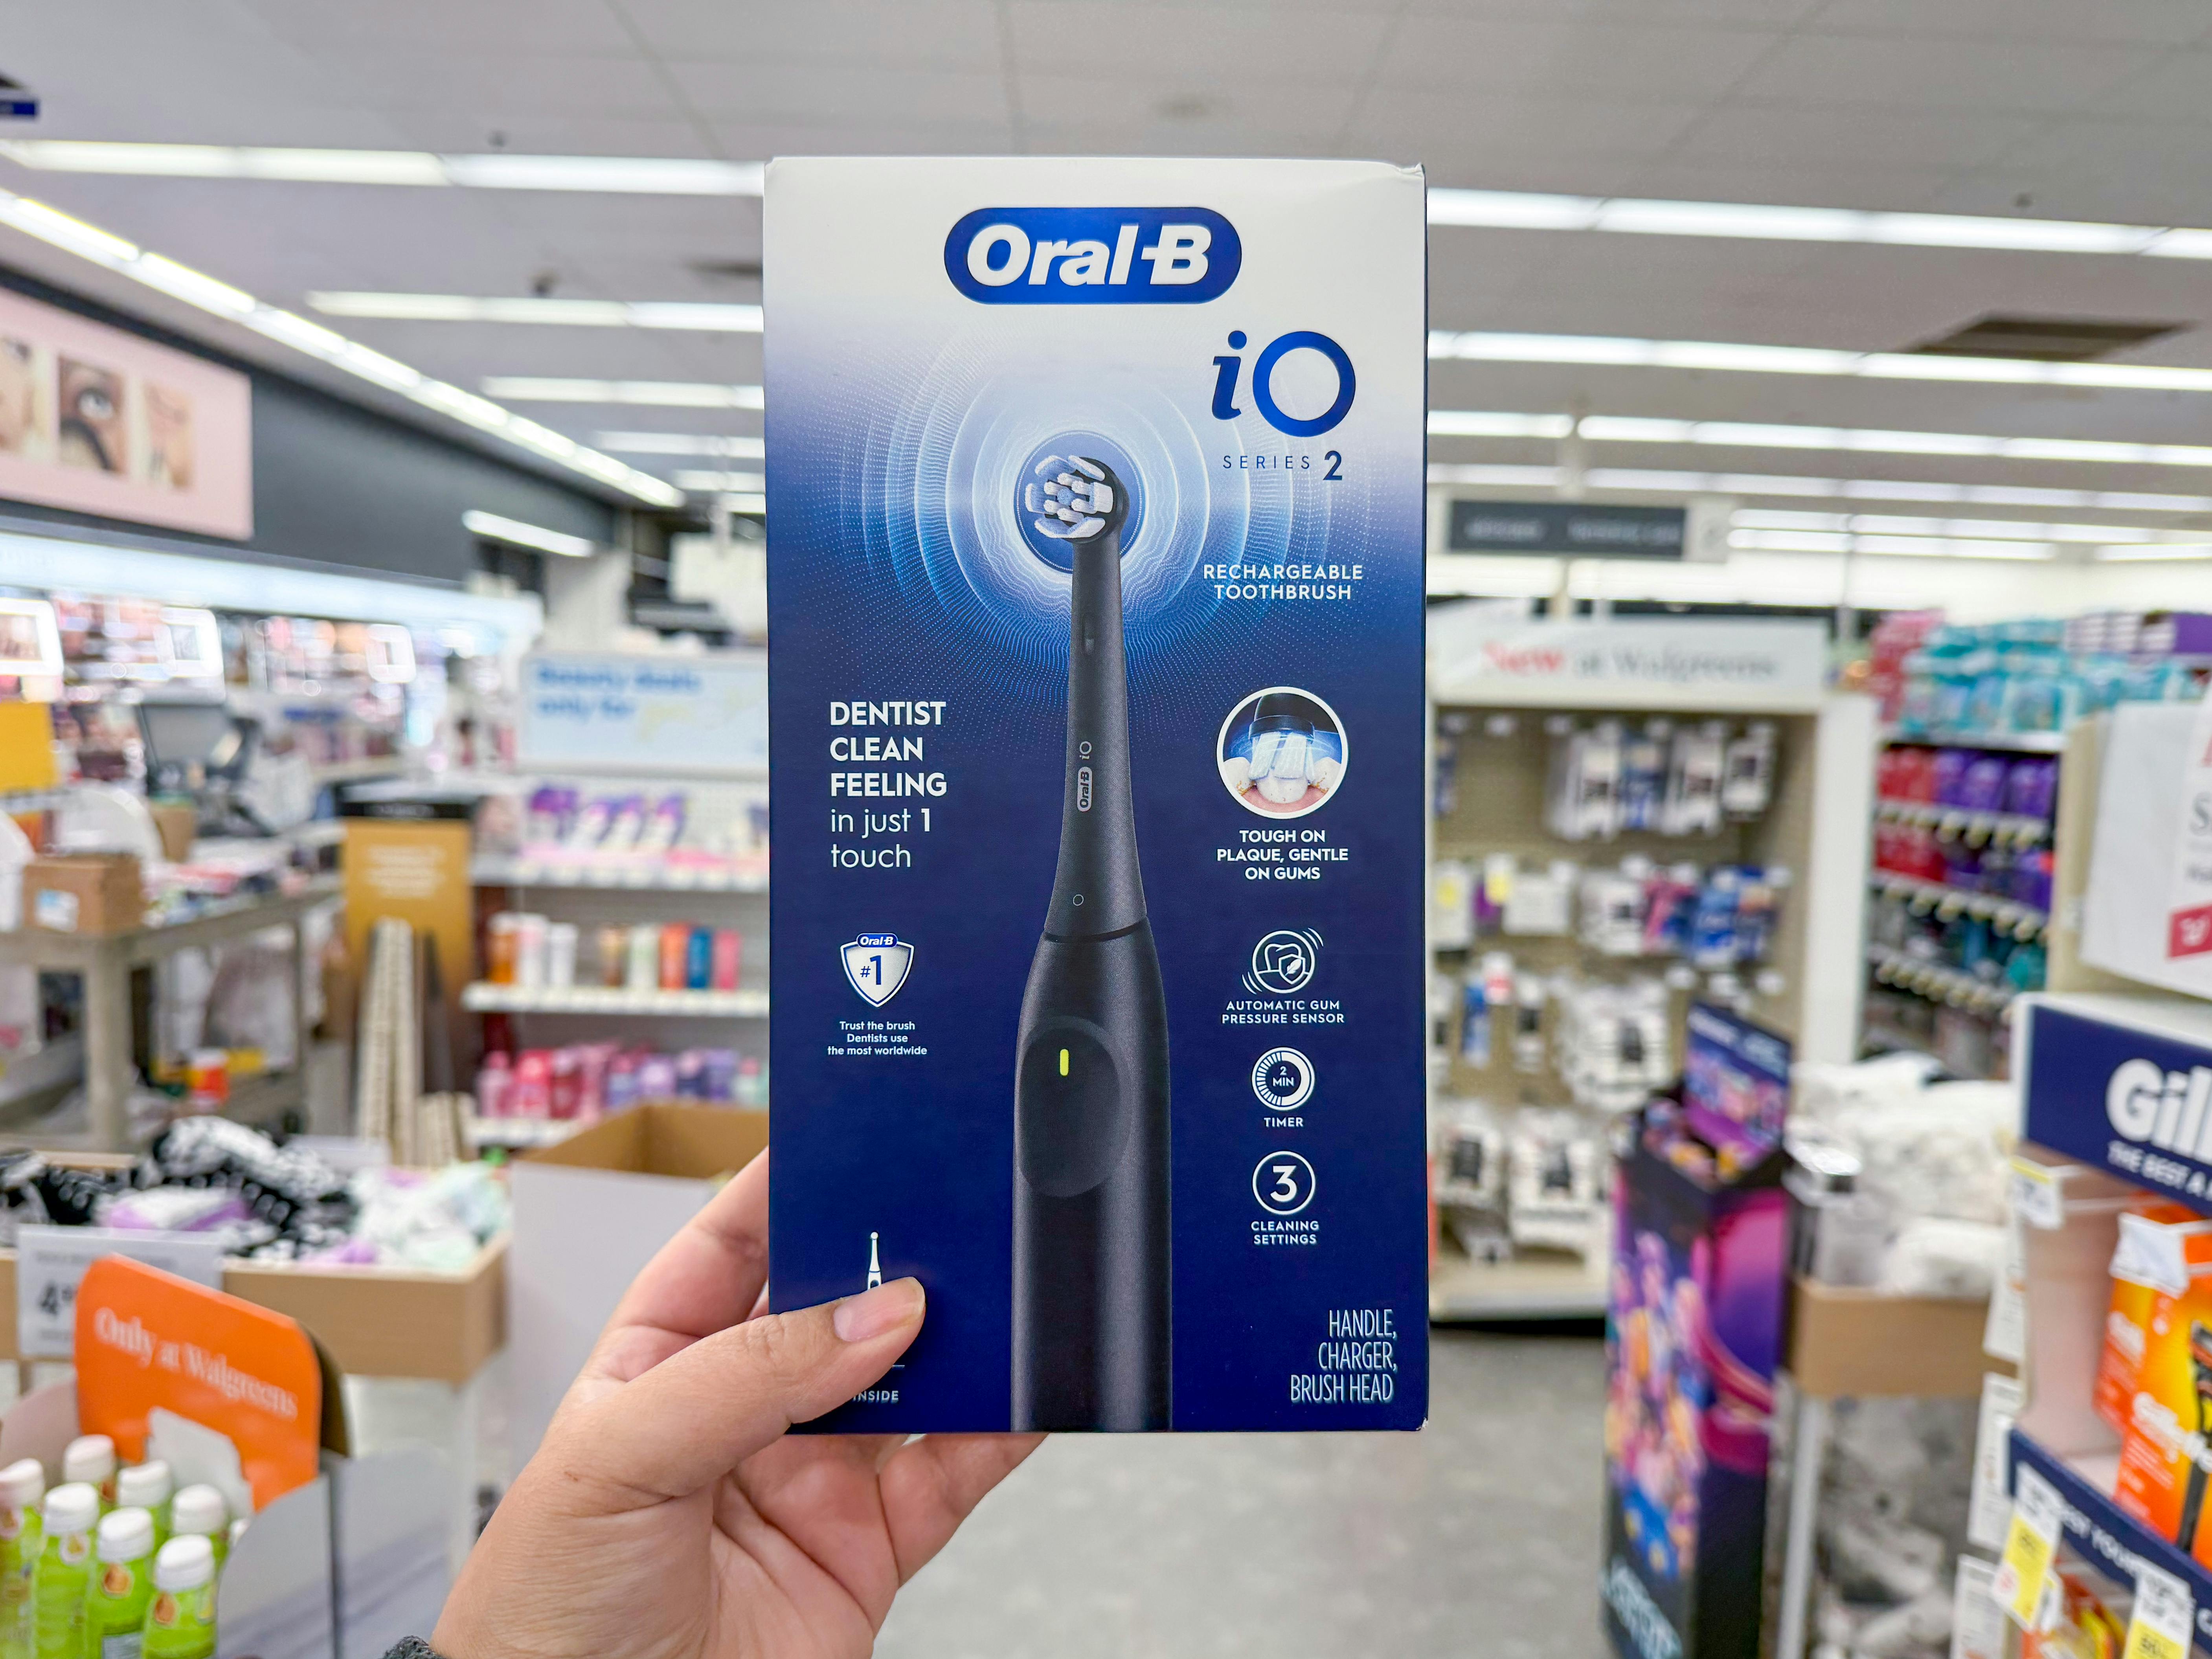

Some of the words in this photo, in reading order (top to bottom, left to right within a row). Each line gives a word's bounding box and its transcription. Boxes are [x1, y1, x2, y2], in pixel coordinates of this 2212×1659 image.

[967, 224, 1211, 286] Oral-B
[1212, 330, 1356, 437] iO
[1223, 455, 1310, 469] SERIES
[1323, 450, 1343, 481] 2
[1203, 564, 1363, 580] RECHARGEABLE
[1214, 584, 1351, 600] TOOTHBRUSH
[830, 701, 946, 726] DENTIST
[830, 736, 923, 761] CLEAN
[831, 772, 947, 797] FEELING
[1080, 771, 1090, 808] Oral-B
[831, 809, 853, 832] in
[862, 808, 911, 839] just
[921, 808, 930, 832] 1
[1239, 830, 1296, 843] TOUGH
[1301, 830, 1325, 842] ON
[831, 843, 911, 868] touch
[1217, 848, 1284, 863] PLAQUE,
[1288, 848, 1348, 861] GENTLE
[1245, 867, 1270, 880] ON
[1274, 867, 1321, 880] GUMS
[860, 936, 893, 945] Oral-B
[1226, 1000, 1305, 1010] AUTOMATIC
[1310, 1000, 1339, 1010] GUM
[839, 1021, 865, 1030] Trust
[867, 1021, 884, 1030] the
[887, 1021, 915, 1030] brush
[1222, 1014, 1288, 1024] PRESSURE
[1292, 1013, 1345, 1023] SENSOR
[847, 1033, 888, 1042] Dentists
[827, 1046, 844, 1055] the
[847, 1046, 872, 1055] most
[874, 1046, 927, 1055] worldwide
[1280, 1066, 1287, 1075] 2
[1273, 1077, 1294, 1086] MIN
[1264, 1117, 1303, 1127] TIMER
[1270, 1165, 1297, 1202] 3
[1251, 1220, 1319, 1231] CLEANING
[1254, 1234, 1317, 1245] SETTINGS
[1329, 1309, 1396, 1339] HANDLE,
[94, 1306, 156, 1367] Only
[1318, 1341, 1397, 1371] CHARGER,
[1291, 1374, 1344, 1402] BRUSH
[1350, 1374, 1393, 1401] HEAD
